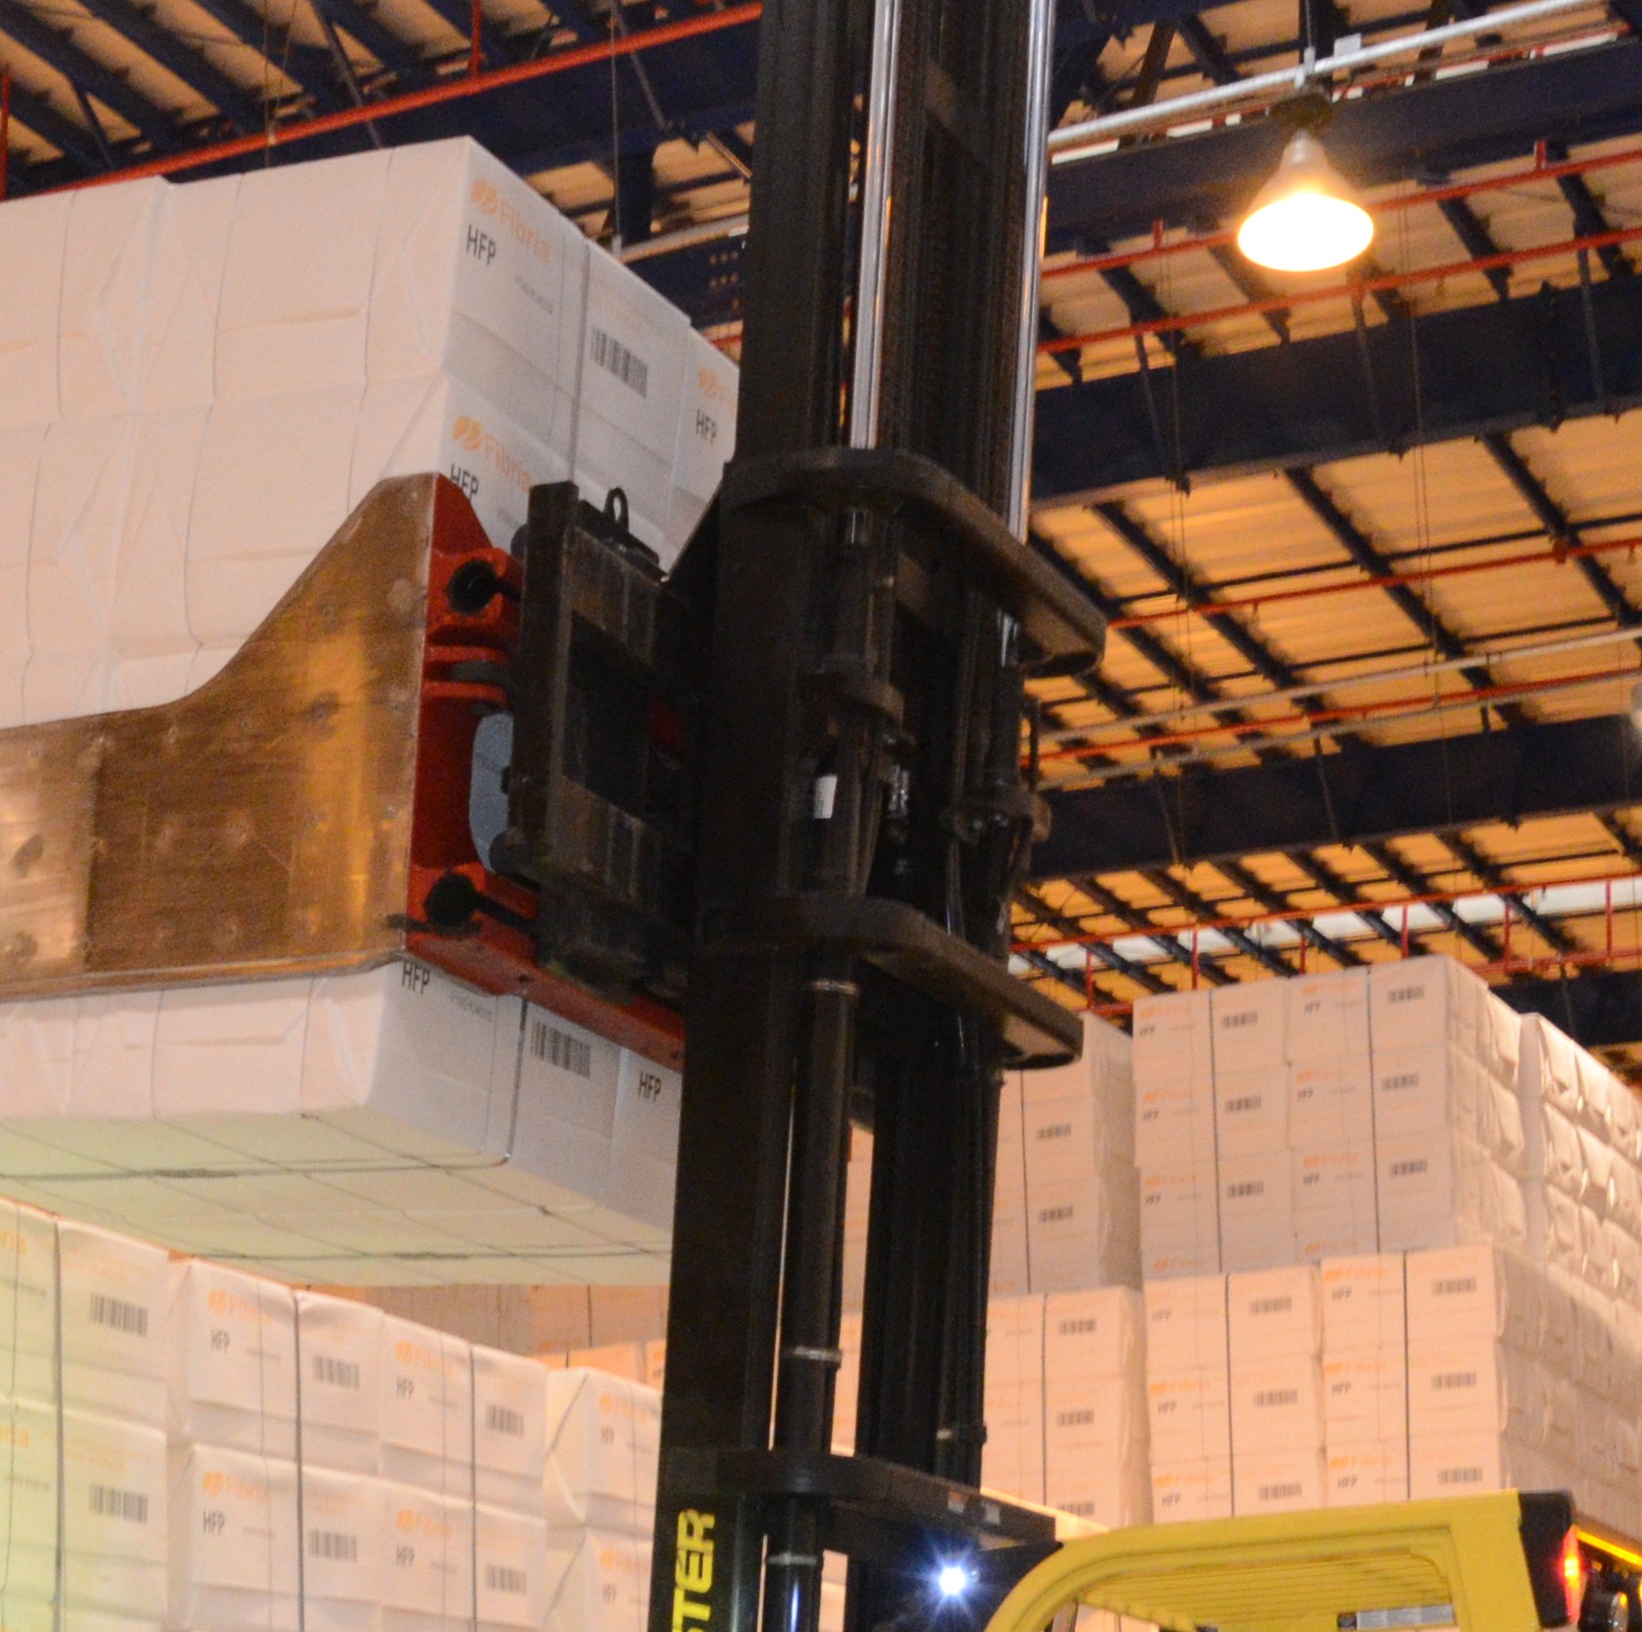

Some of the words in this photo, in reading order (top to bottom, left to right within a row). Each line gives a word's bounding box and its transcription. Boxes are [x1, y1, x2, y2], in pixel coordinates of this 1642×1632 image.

[466, 224, 496, 266] HFP
[695, 408, 718, 444] HFP
[402, 960, 430, 994] HFP
[638, 1070, 662, 1102] HFP
